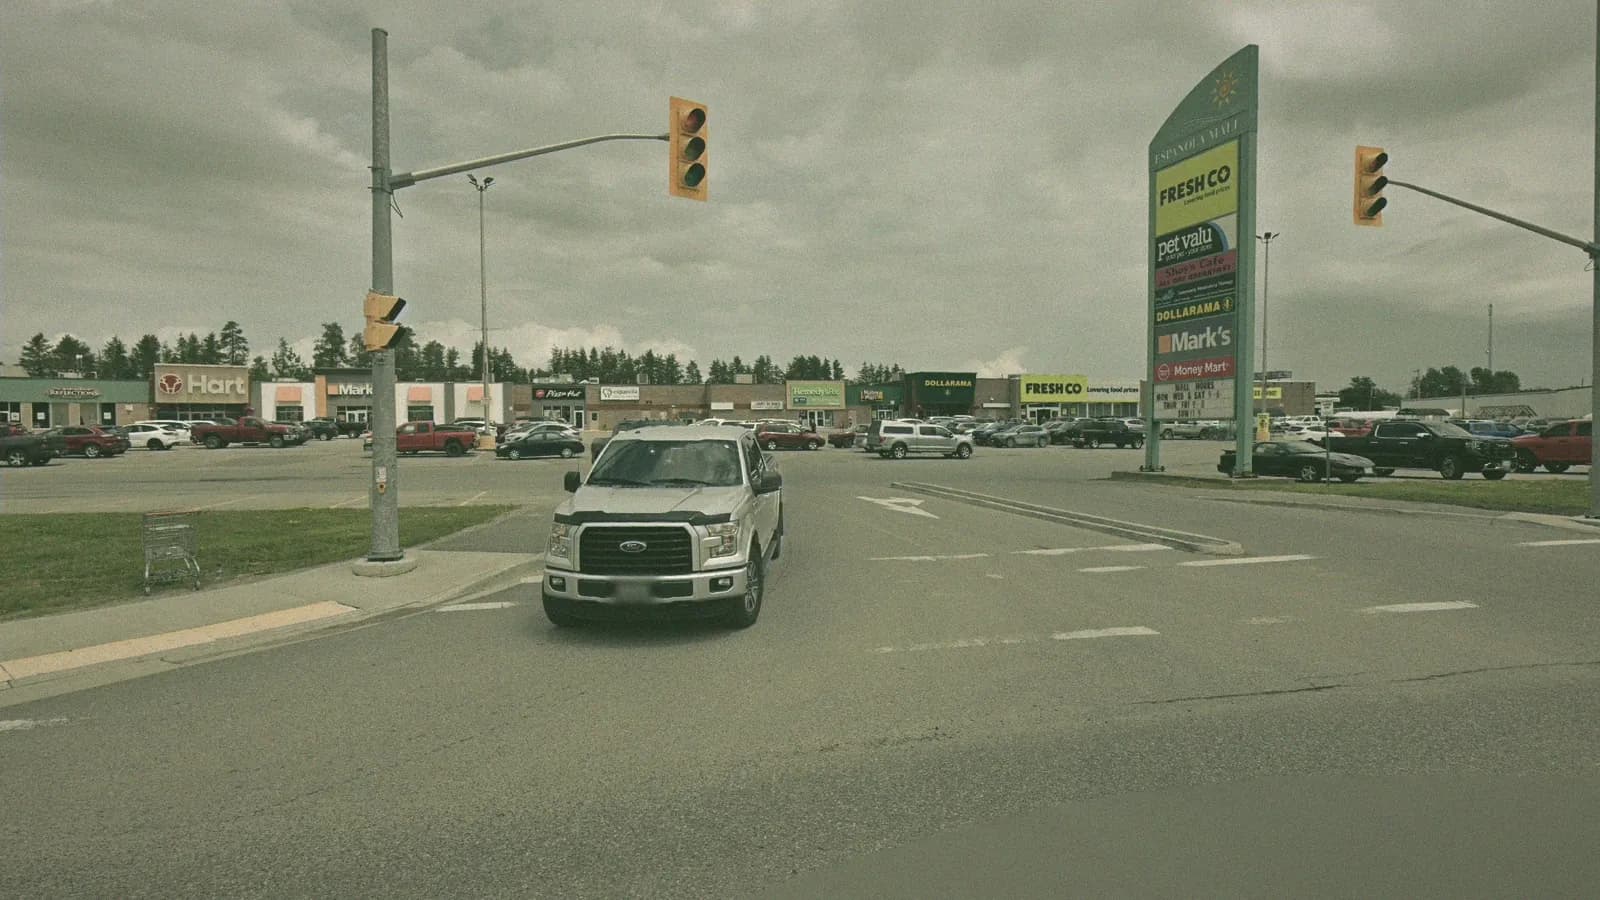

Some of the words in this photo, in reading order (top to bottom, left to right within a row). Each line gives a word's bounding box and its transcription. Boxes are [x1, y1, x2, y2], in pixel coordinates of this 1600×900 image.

[1155, 135, 1207, 164] ESPANOLA
[1209, 119, 1239, 140] MALL
[1158, 235, 1180, 262] pet
[1182, 227, 1212, 249] valu
[1156, 301, 1220, 322] DOLLARAMA
[1172, 326, 1231, 353] Mark's
[1174, 364, 1203, 377] Money
[1205, 361, 1226, 373] Mart
[187, 374, 245, 395] Hart
[546, 389, 566, 398] Pizza
[567, 389, 582, 398] Hut
[924, 379, 972, 388] DOLLARAMA
[1087, 386, 1109, 394] Lowering
[1123, 386, 1138, 394] prices
